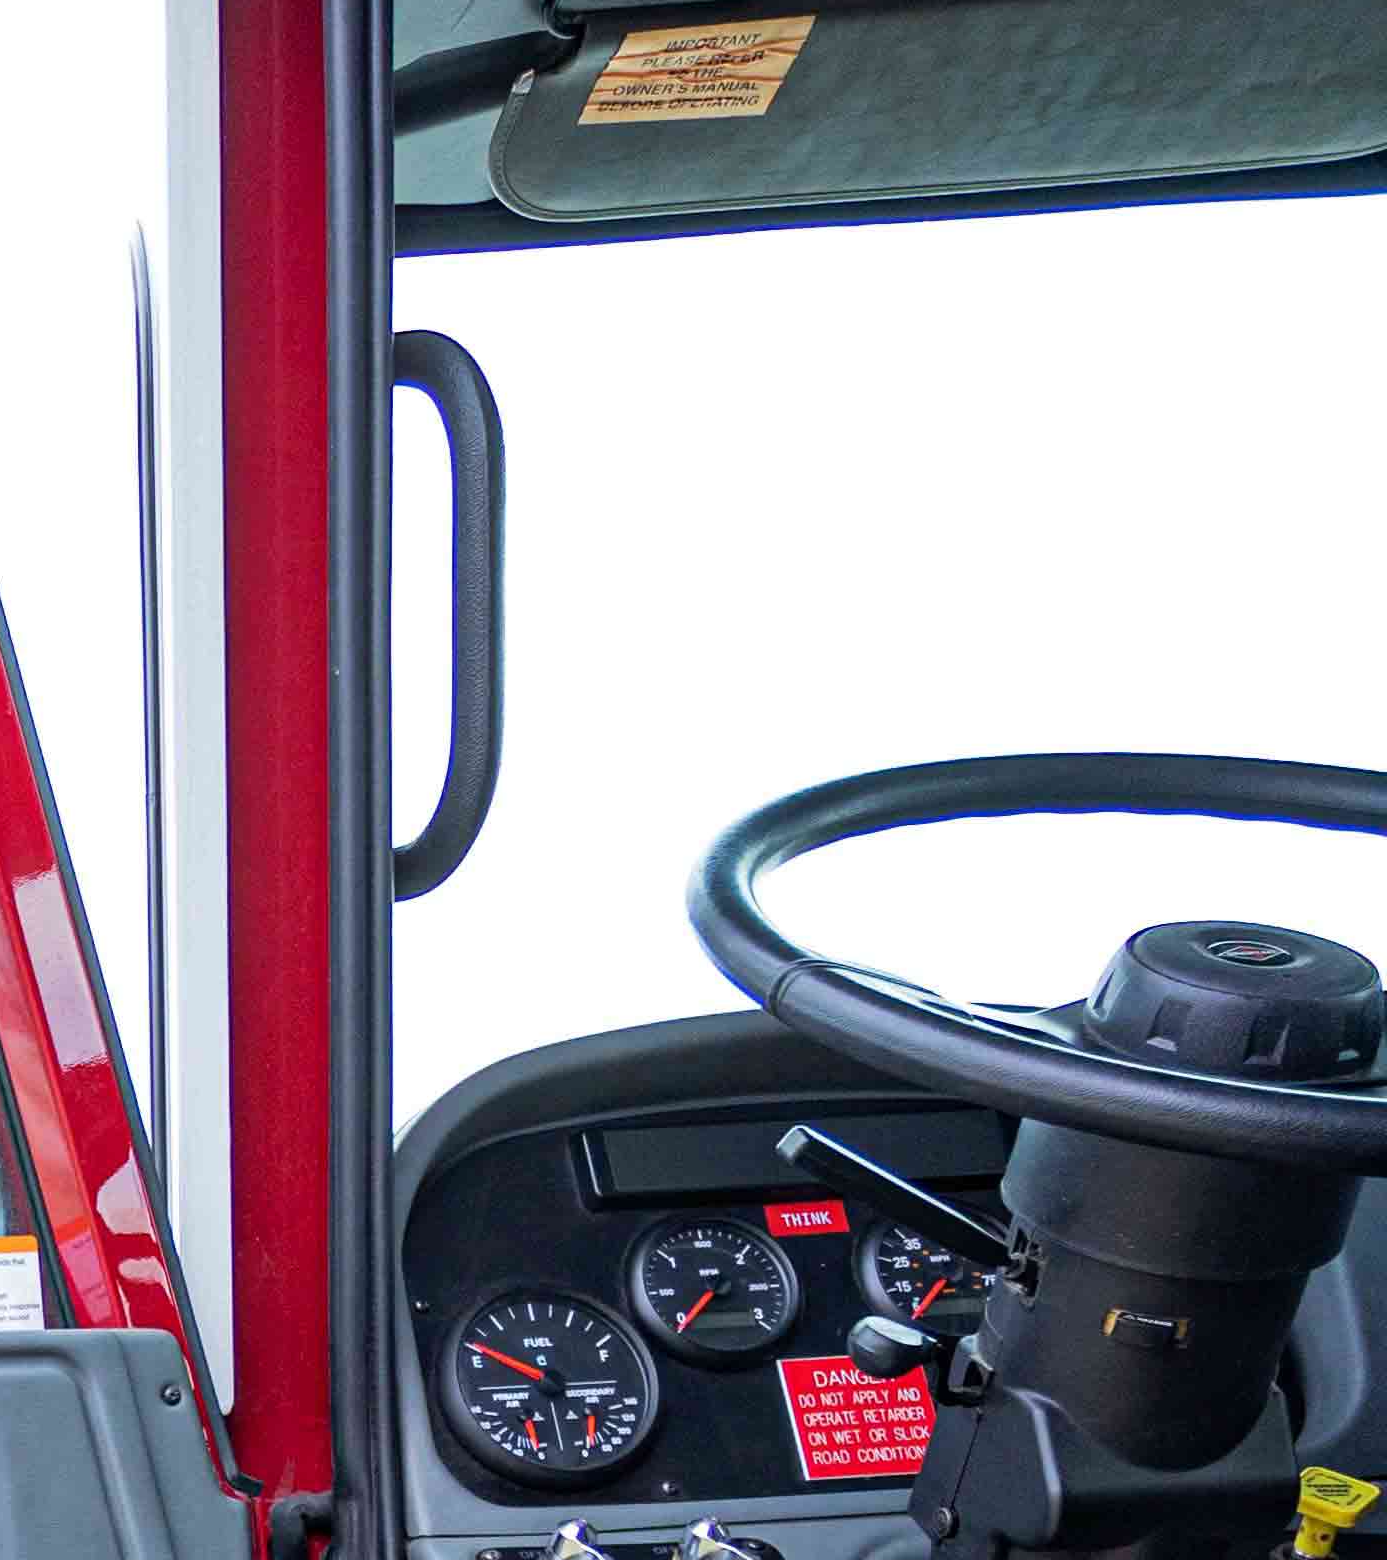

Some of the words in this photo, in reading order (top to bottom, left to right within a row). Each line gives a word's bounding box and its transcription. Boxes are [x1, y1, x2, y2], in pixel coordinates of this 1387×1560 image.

[666, 33, 763, 52] IMPORTANT
[642, 54, 707, 68] PLEASE
[692, 67, 725, 78] THE
[612, 83, 689, 96] OWNER'S
[691, 81, 760, 92] MANUAL
[667, 95, 761, 110] OPERATING
[781, 1211, 833, 1228] THINK
[903, 1238, 922, 1250] 35
[734, 1254, 746, 1265] 2
[892, 1256, 910, 1269] 25
[895, 1280, 912, 1292] 15
[753, 1308, 764, 1320] 3
[522, 1338, 554, 1348] FUEL
[471, 1355, 484, 1368] E
[599, 1349, 610, 1362] F
[813, 1369, 896, 1388] DANG
[798, 1393, 816, 1409] DO
[820, 1391, 844, 1407] NOT
[852, 1389, 890, 1405] APPLY
[898, 1387, 921, 1402] AND
[803, 1410, 859, 1427] OPERATE
[862, 1406, 926, 1424] RETARDER
[808, 1431, 827, 1446] ON
[832, 1429, 862, 1445] WET
[869, 1428, 887, 1443] OR
[894, 1425, 931, 1441] SLICK
[812, 1450, 851, 1465] ROAD
